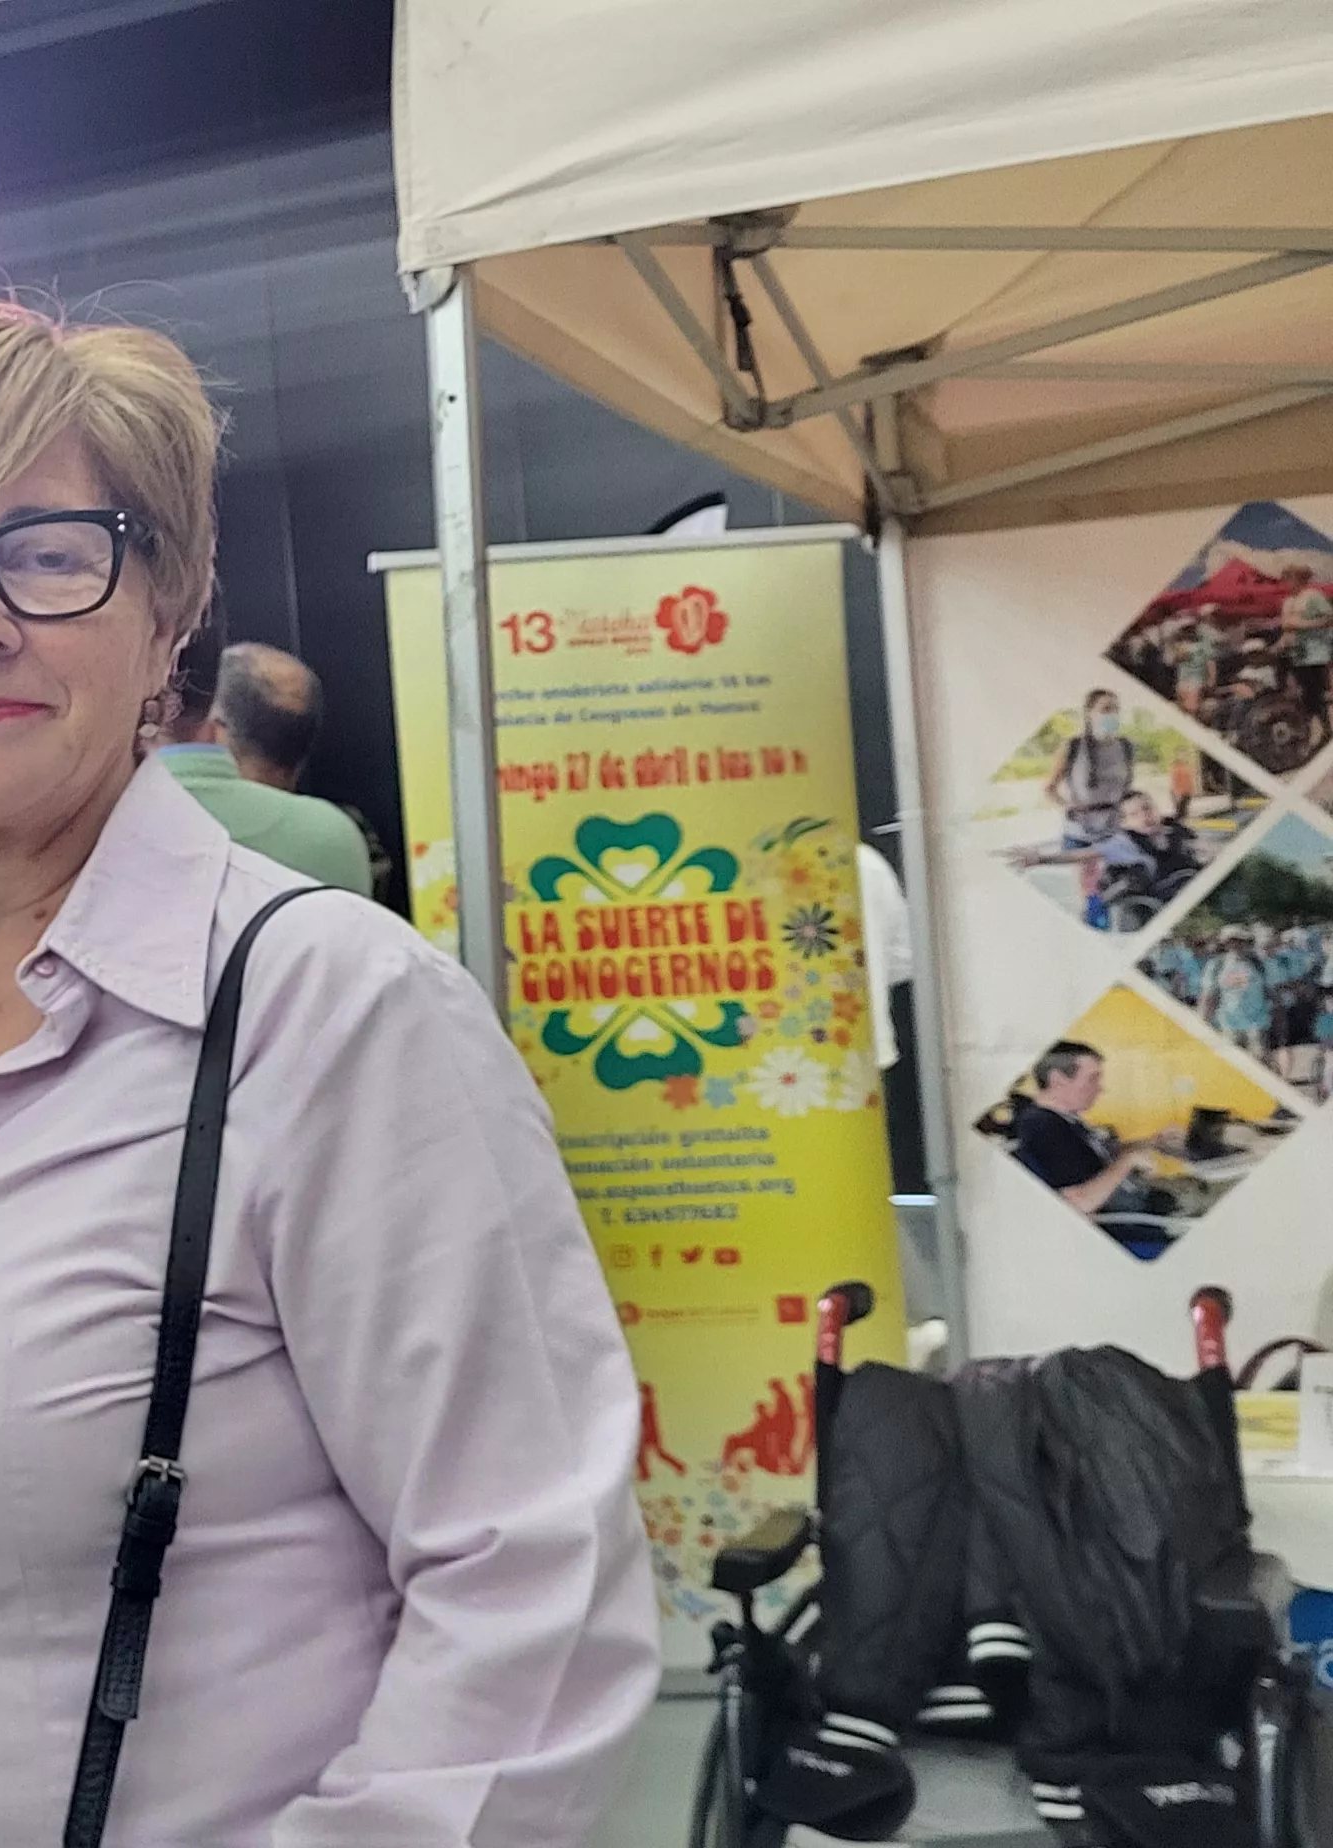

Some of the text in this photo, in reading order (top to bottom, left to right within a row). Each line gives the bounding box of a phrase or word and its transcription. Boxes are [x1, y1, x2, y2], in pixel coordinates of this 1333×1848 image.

[500, 610, 556, 654] 13
[519, 898, 770, 955] LA SUERTE DE
